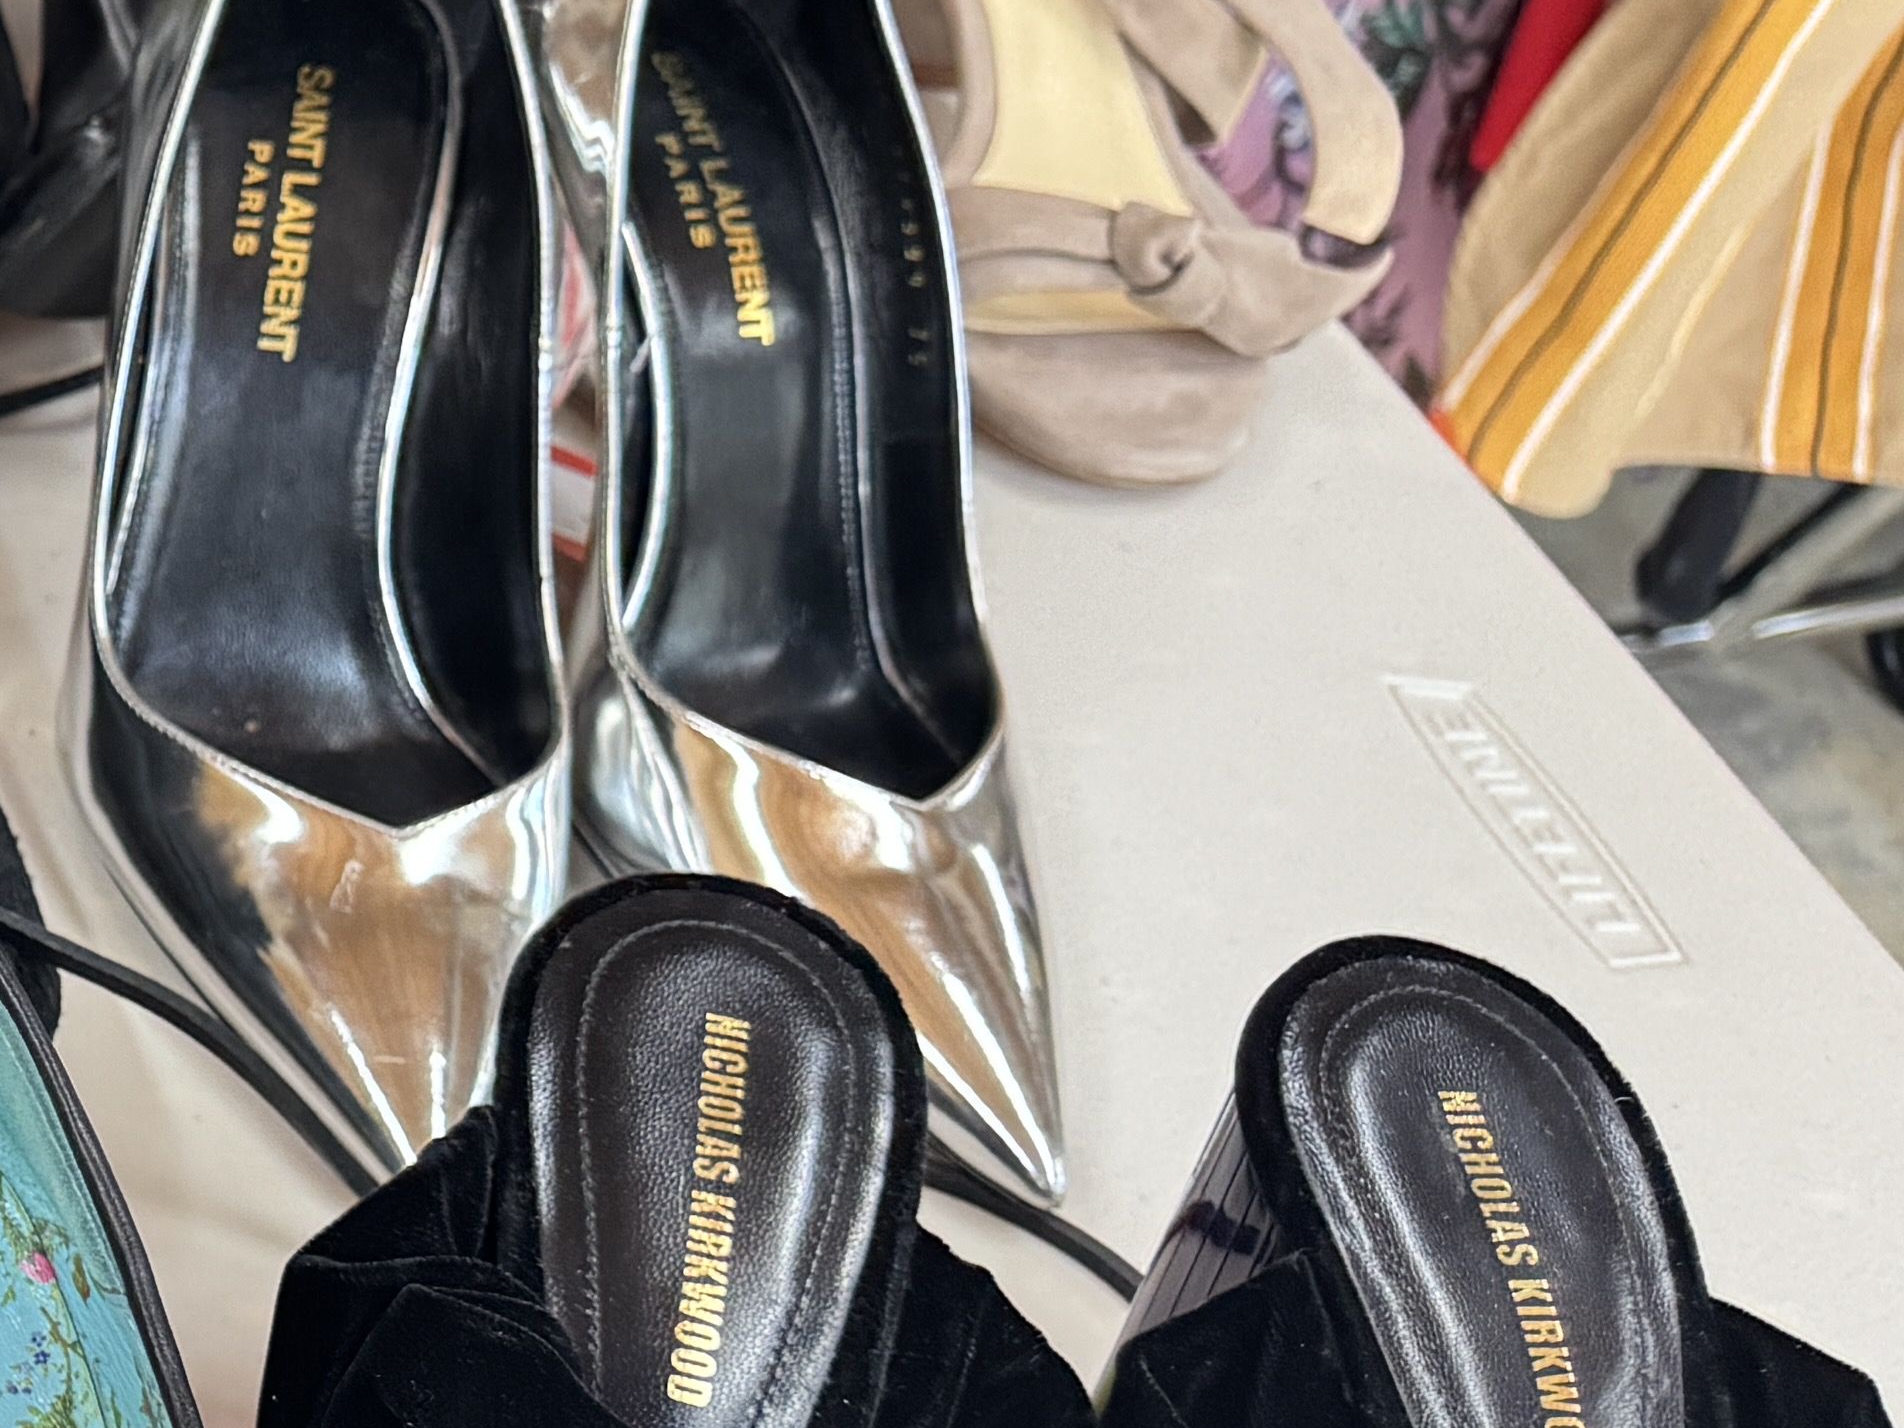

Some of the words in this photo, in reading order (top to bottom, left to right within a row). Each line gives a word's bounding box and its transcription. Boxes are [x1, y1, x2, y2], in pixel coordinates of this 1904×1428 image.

[231, 138, 276, 260] PARIS
[286, 63, 335, 169] SAINT
[651, 50, 720, 152] SAINT
[699, 153, 776, 347] LAURENT
[655, 133, 717, 251] PARIS
[256, 172, 323, 363] LAURENT
[692, 1012, 752, 1186] NICHOLAS
[1438, 1090, 1539, 1268] NICHOLAS
[666, 1189, 737, 1408] KIRKWOOD
